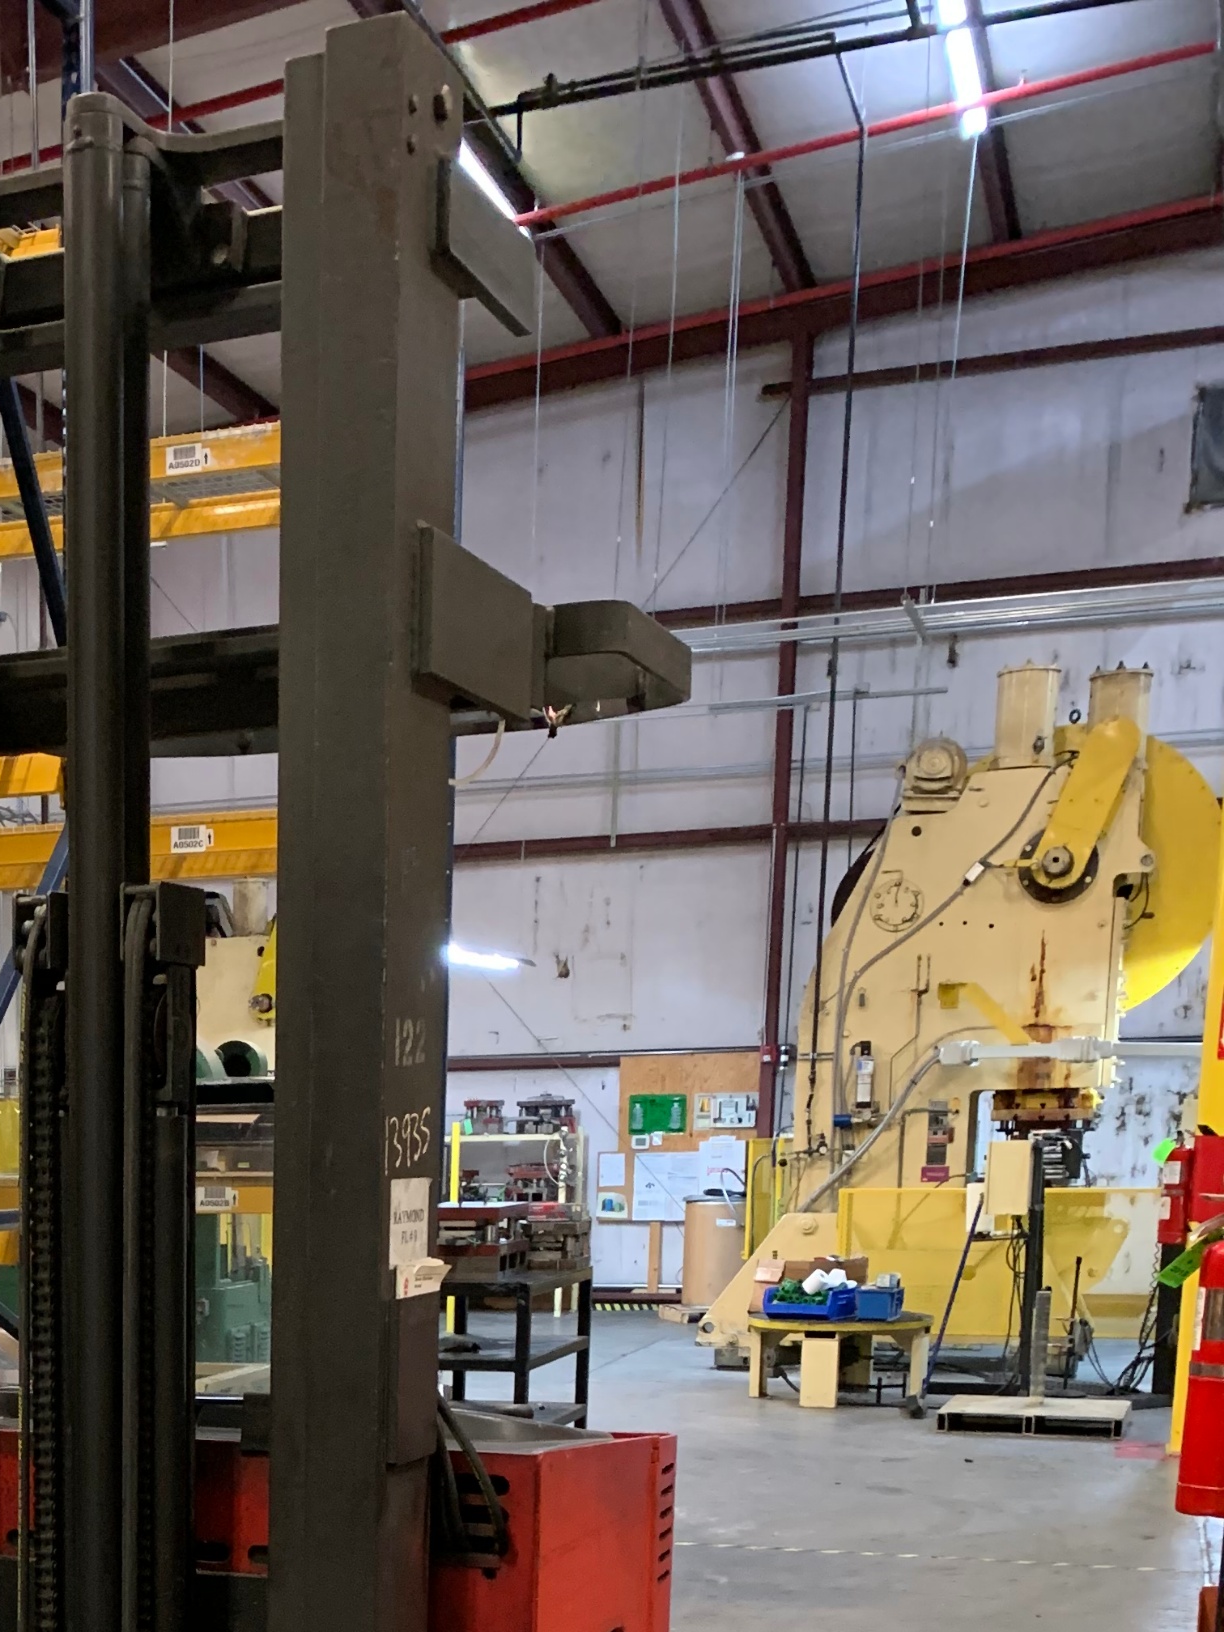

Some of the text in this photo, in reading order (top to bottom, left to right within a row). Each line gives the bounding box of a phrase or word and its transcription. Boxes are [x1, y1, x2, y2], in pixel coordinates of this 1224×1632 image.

[168, 458, 200, 470] A0502D
[173, 839, 204, 849] A0502C
[394, 1017, 426, 1067] 122
[385, 1106, 431, 1176] 13935
[393, 1208, 425, 1225] RAYMOND
